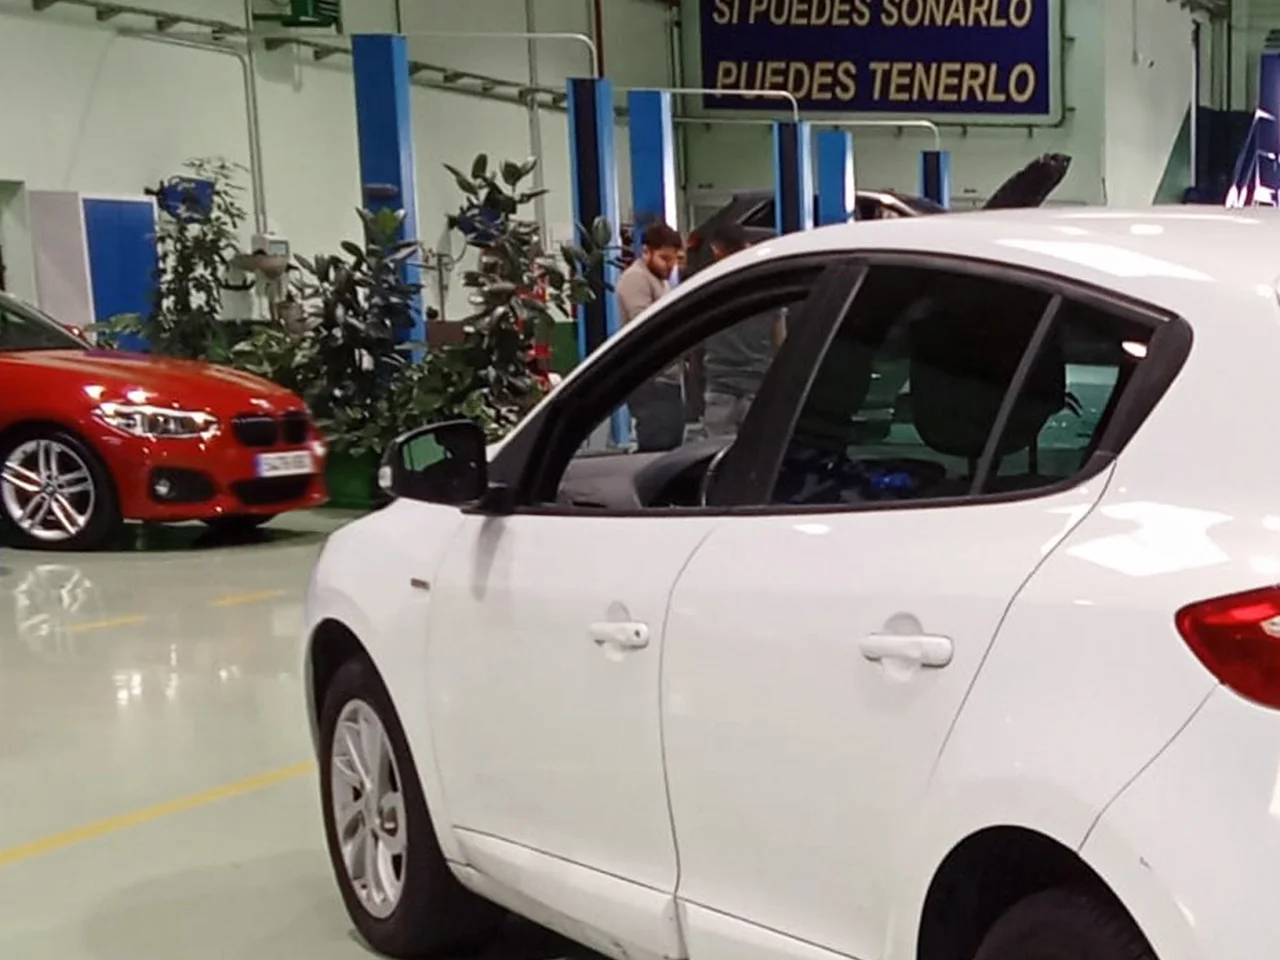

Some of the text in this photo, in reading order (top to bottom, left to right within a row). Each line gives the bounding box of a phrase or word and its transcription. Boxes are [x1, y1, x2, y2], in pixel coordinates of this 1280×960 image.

[712, 0, 740, 25] SI
[748, 0, 872, 26] PUEDES
[715, 60, 1037, 103] PUEDES TENERLO
